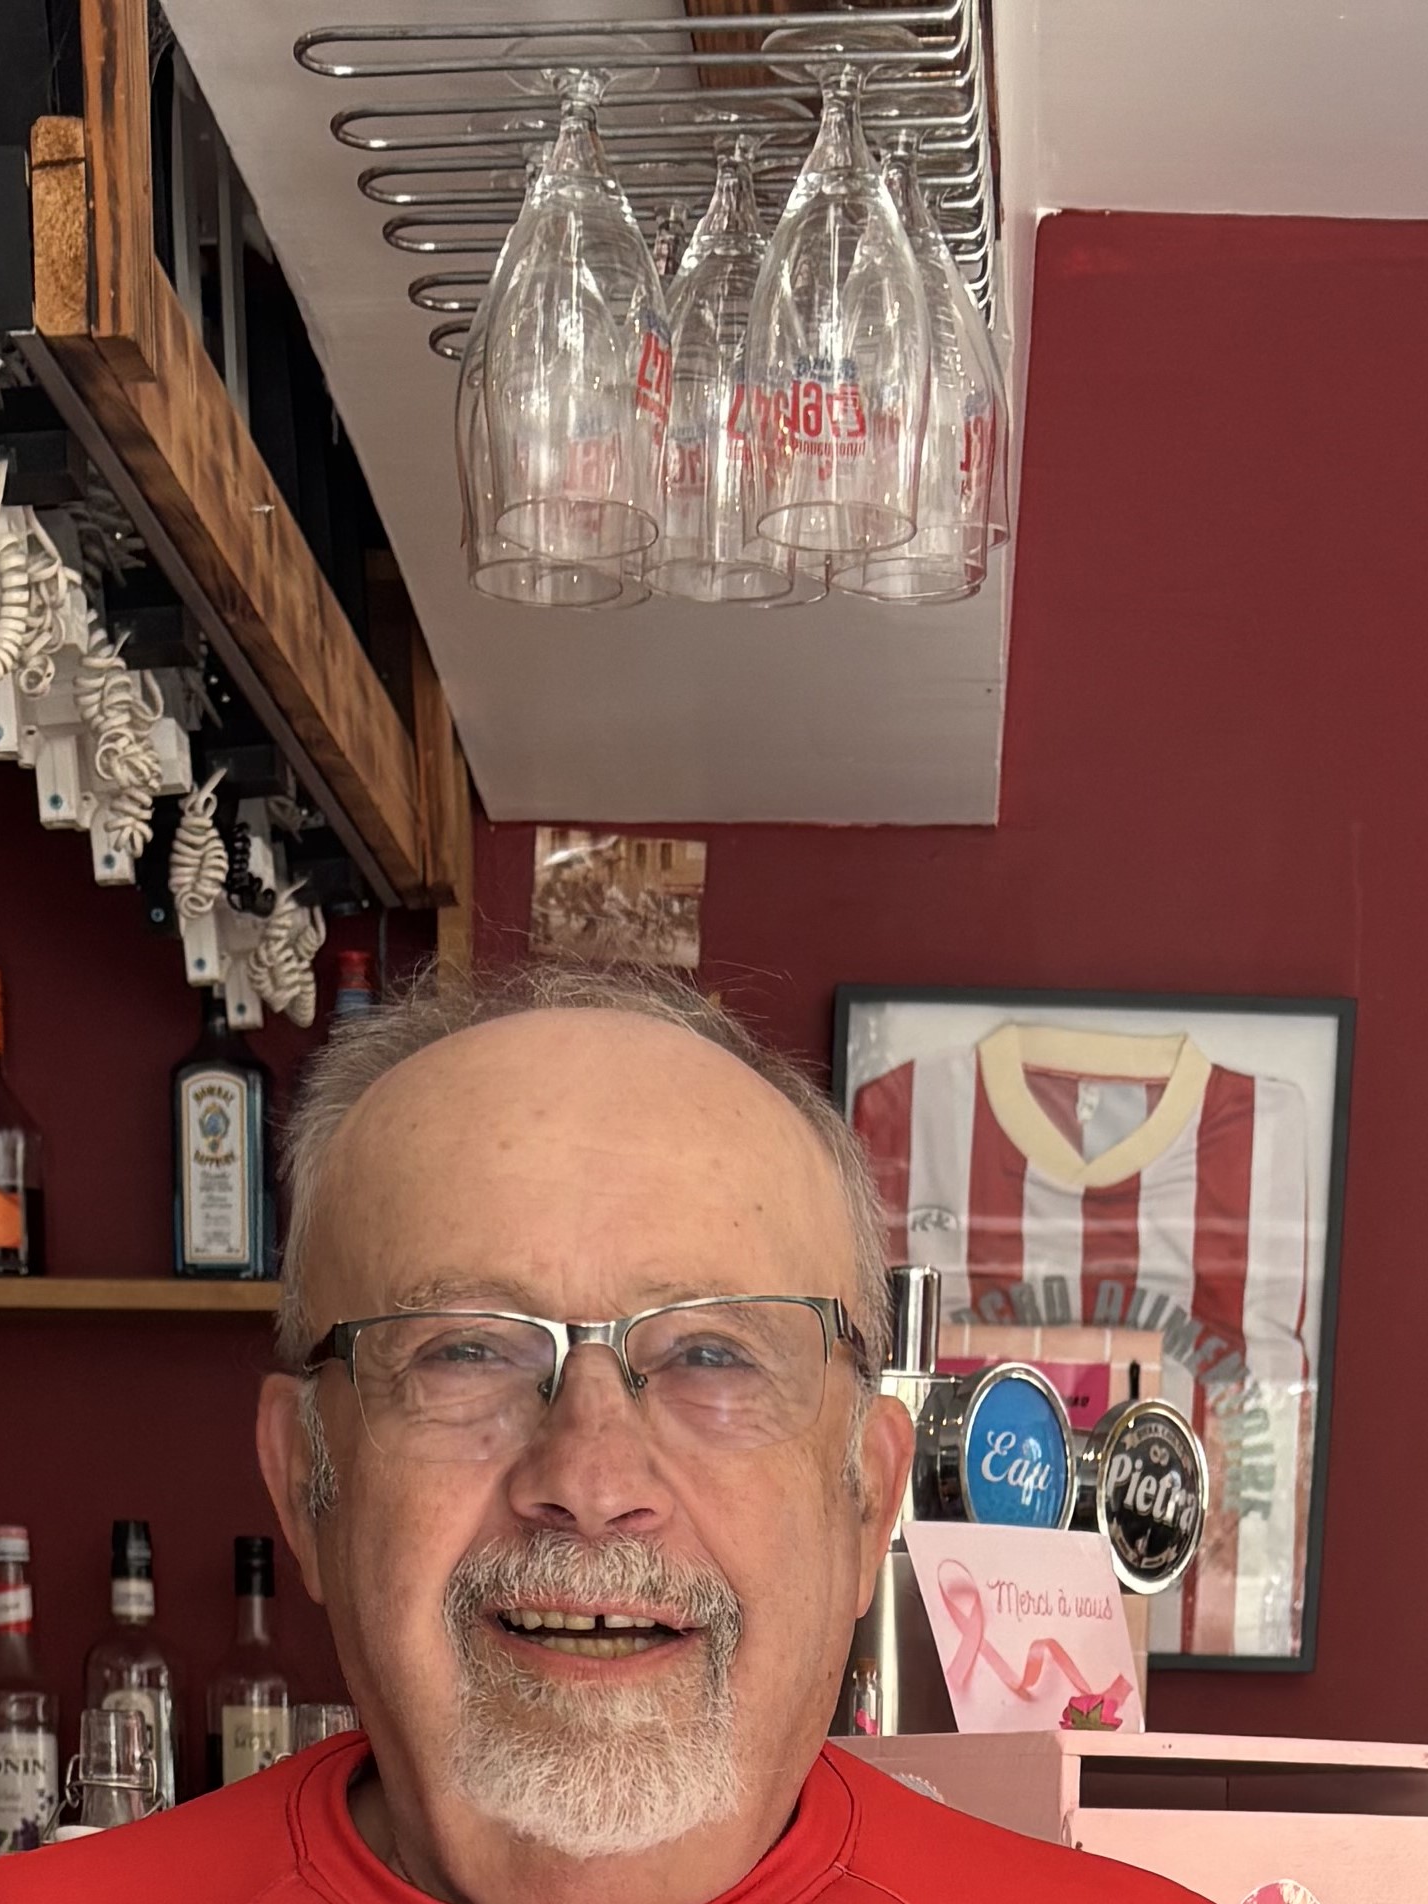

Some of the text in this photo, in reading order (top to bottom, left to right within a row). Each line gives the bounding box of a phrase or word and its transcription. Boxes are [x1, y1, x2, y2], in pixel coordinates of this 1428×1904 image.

[1106, 1453, 1197, 1534] Pietra
[987, 1578, 1113, 1622] Merci à vous
